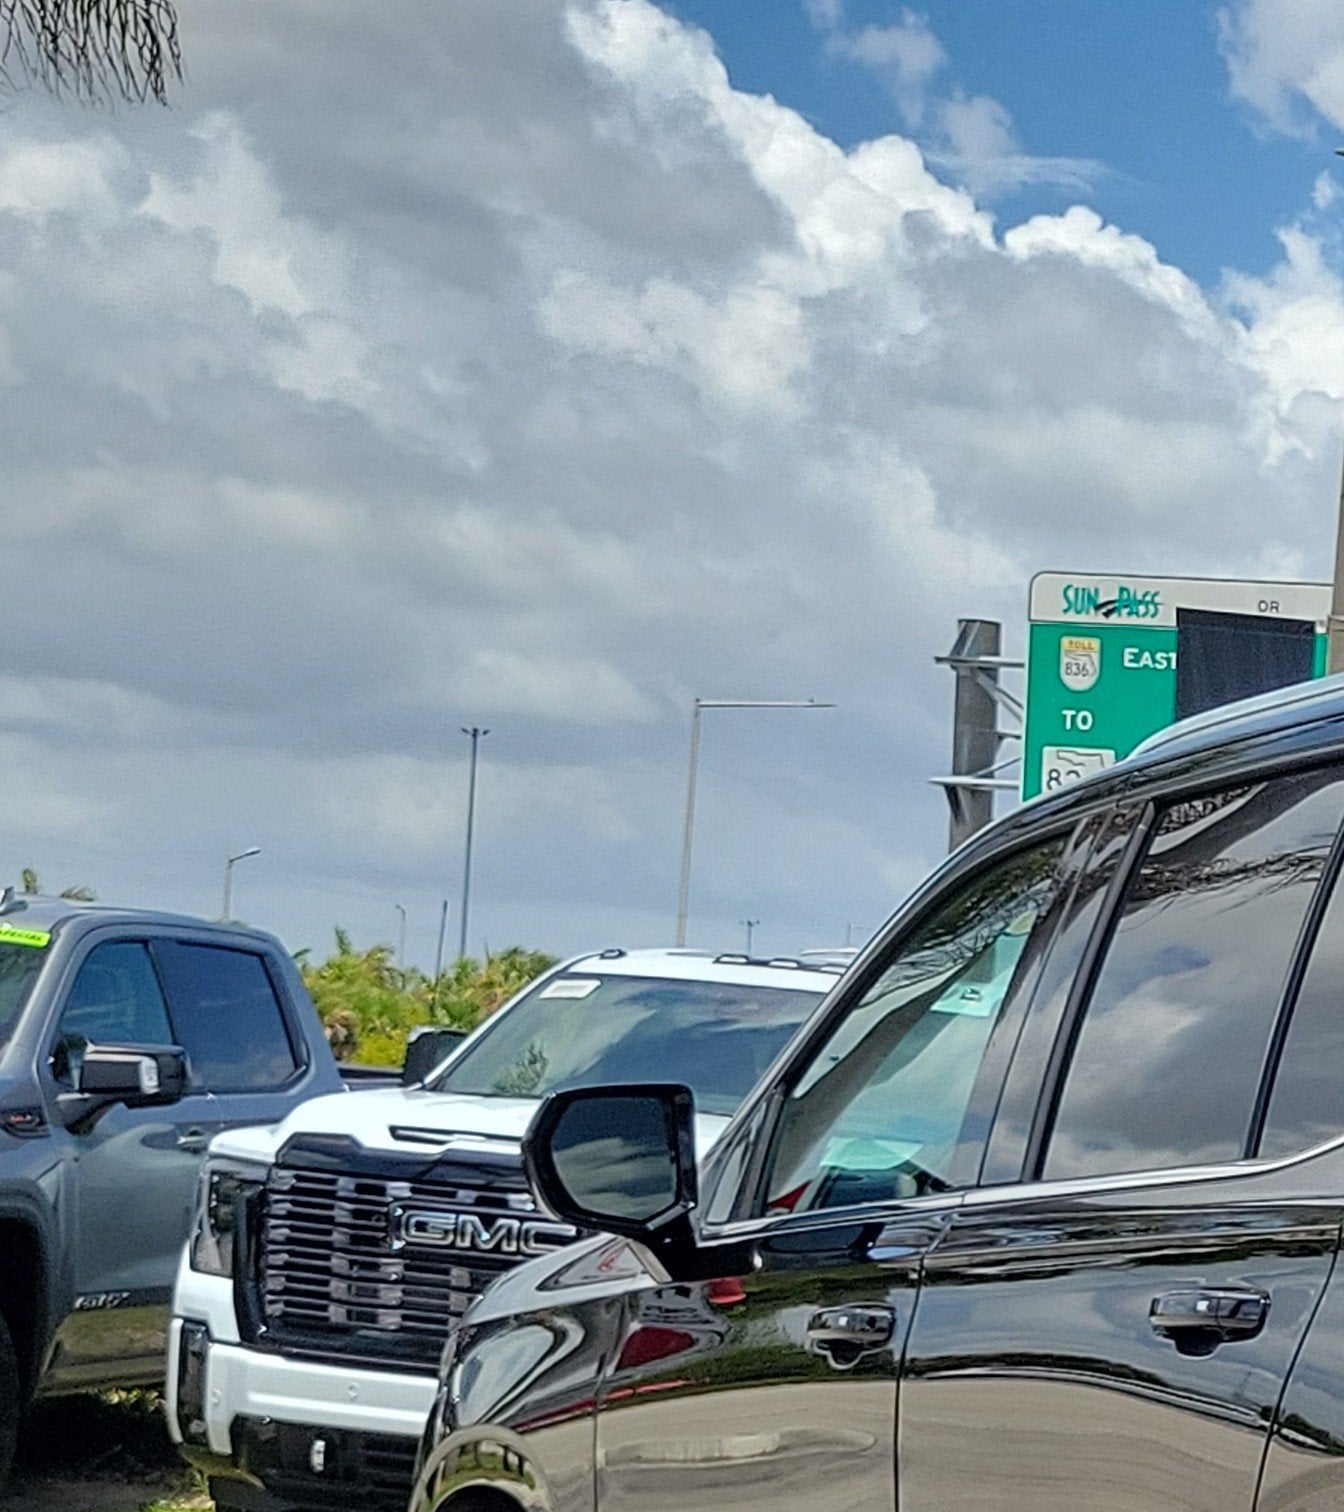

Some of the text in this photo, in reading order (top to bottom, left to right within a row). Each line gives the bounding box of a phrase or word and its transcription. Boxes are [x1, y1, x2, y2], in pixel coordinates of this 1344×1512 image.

[1258, 600, 1280, 613] OR
[1065, 661, 1090, 677] 836
[1123, 647, 1177, 670] EAST
[1061, 709, 1093, 731] TO
[401, 1209, 577, 1256] GMC
